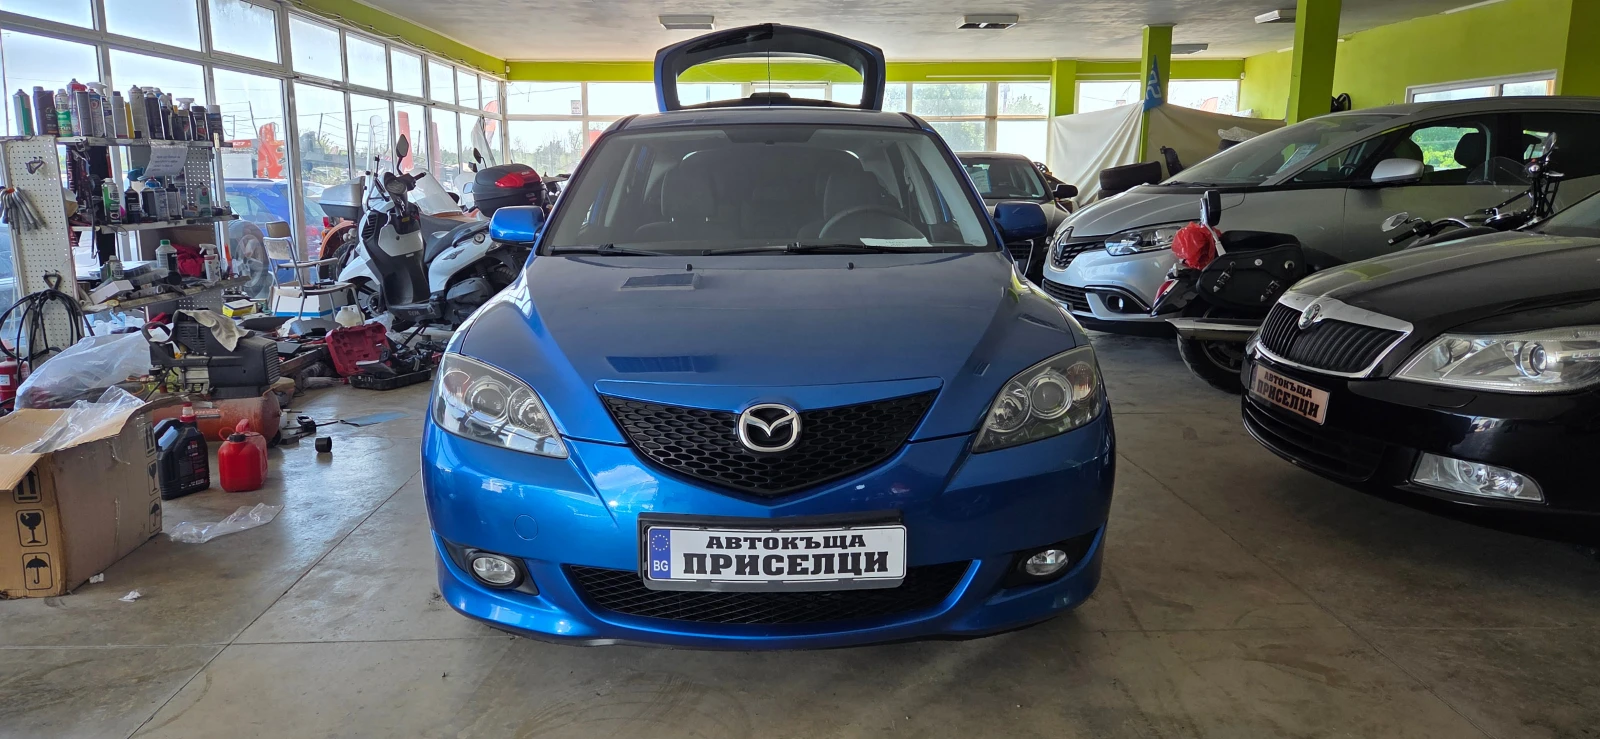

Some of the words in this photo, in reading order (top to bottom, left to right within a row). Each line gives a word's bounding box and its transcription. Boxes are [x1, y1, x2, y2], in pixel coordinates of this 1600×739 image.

[1264, 371, 1312, 398] АВТОКЪЩА
[1257, 379, 1320, 418] ПРИСЕЛЦИ
[706, 534, 866, 550] АВТОКЪЩА
[653, 560, 669, 572] BG
[683, 550, 889, 576] ПРИСЕЛЦИ
